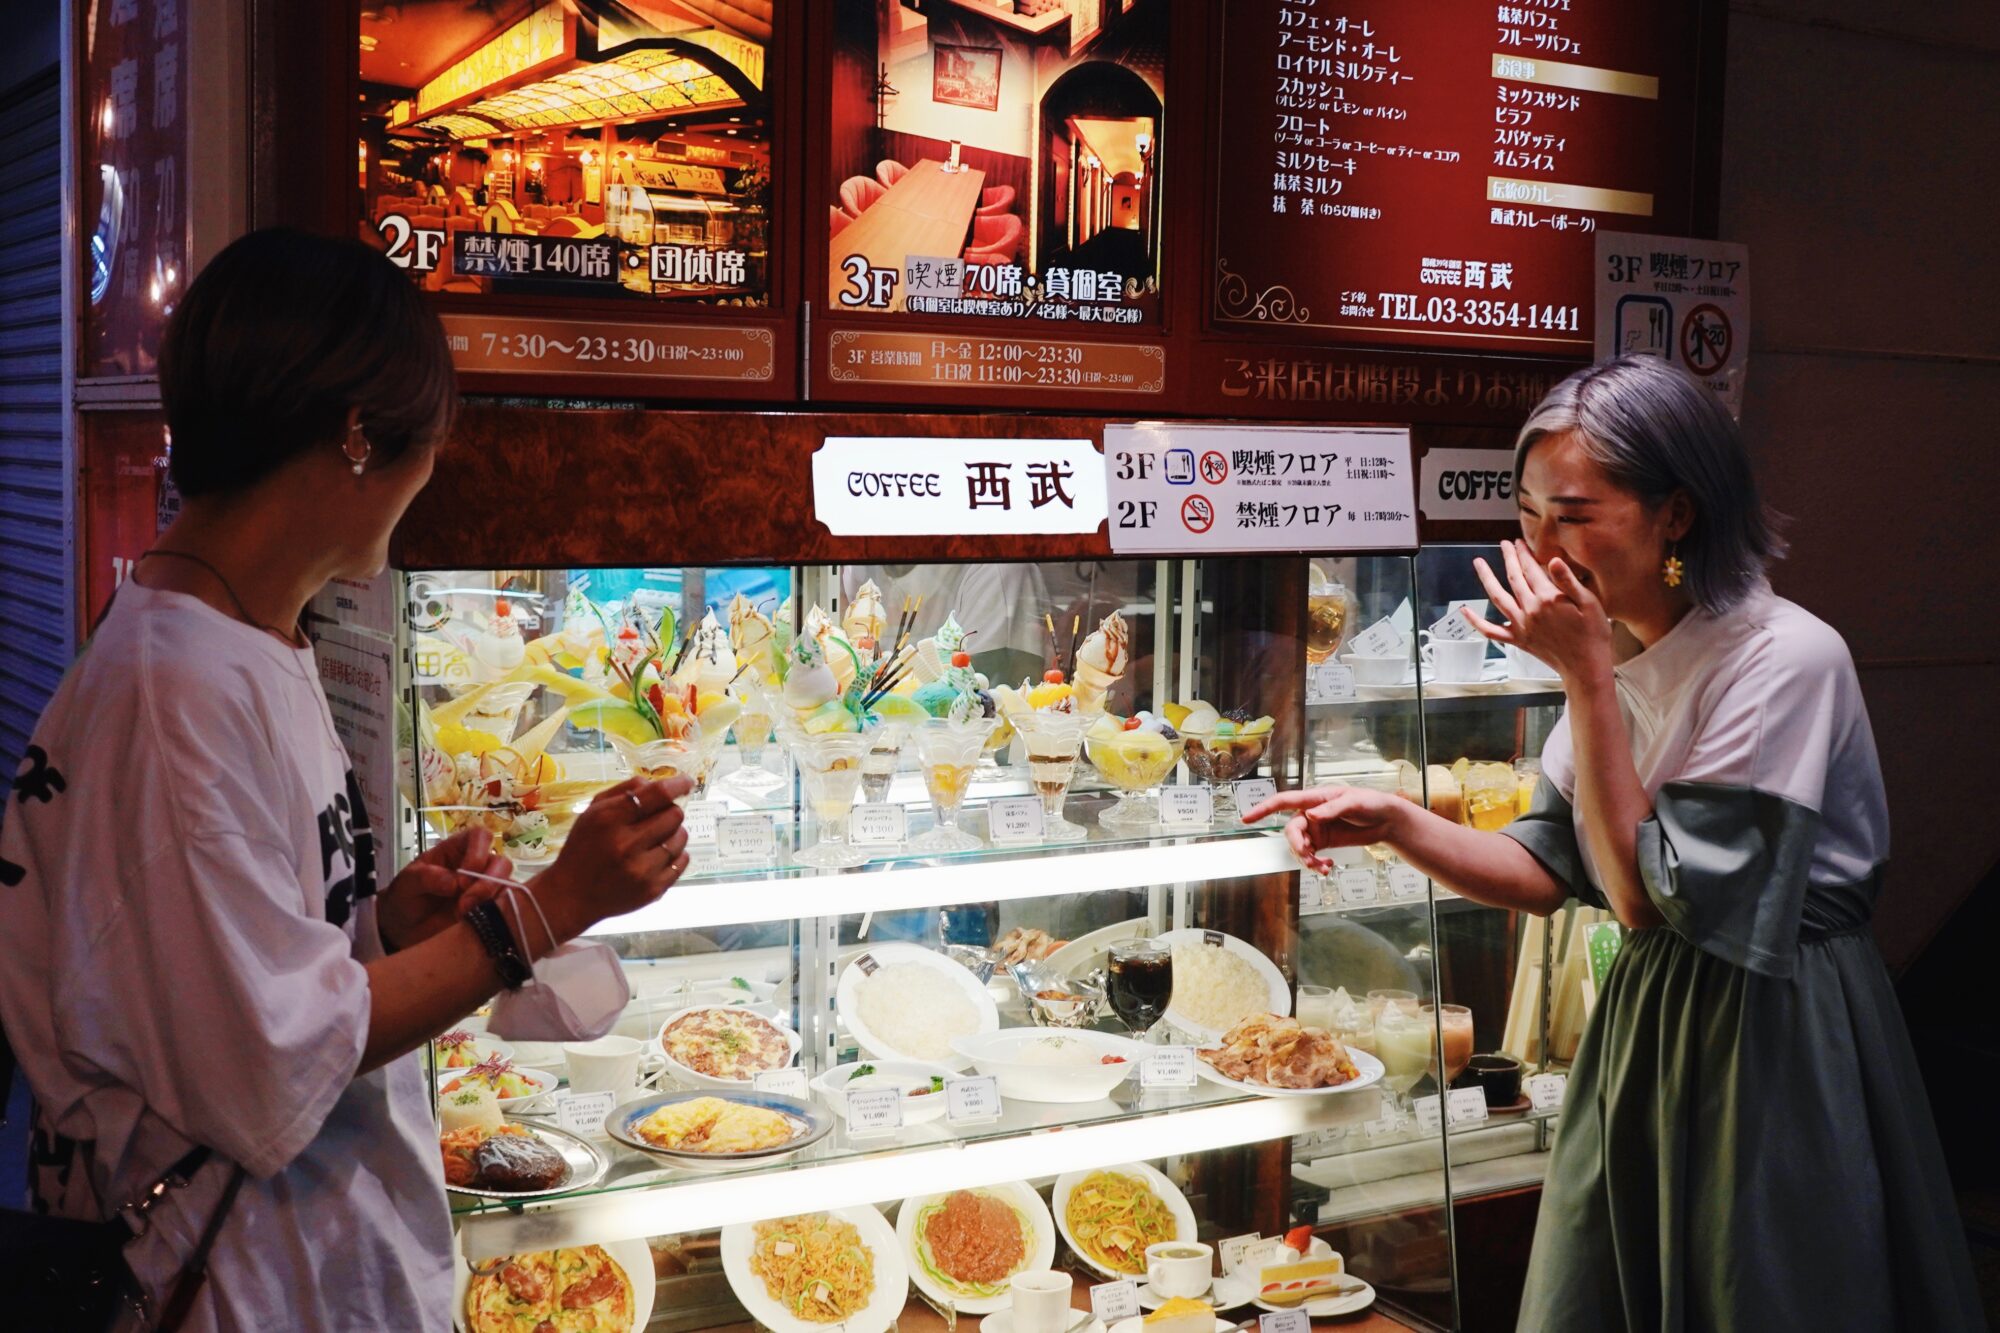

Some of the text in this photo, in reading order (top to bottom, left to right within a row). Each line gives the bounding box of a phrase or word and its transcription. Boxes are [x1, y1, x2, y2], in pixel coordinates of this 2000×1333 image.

[1279, 8, 1375, 37] カフェ・オーレ
[1497, 5, 1558, 30] 抹茶パフェ
[1278, 31, 1401, 62] アーモンド・オーレ
[1498, 28, 1581, 54] フルーツパフェ
[1278, 54, 1413, 85] ロイヤルミルクティー
[1497, 58, 1535, 80] お食事
[1277, 77, 1344, 100] スカッシュ
[1497, 85, 1580, 111] ミックスサンド
[1334, 102, 1360, 115] レモン
[1495, 107, 1532, 126] ピラフ
[1276, 114, 1330, 135] フロート
[1316, 136, 1341, 150] コーラ
[1354, 142, 1385, 154] コーヒー
[1494, 128, 1566, 151] スパゲッティ
[1276, 151, 1357, 176] ミルクセーキ
[1493, 149, 1555, 171] オムライス
[1273, 173, 1342, 195] 抹茶ミルク
[1492, 181, 1568, 203] 伝統のカレー
[379, 215, 445, 270] 2F
[1420, 261, 1513, 290] COFFEE 西武
[1607, 252, 1741, 283] 3F 喫煙フロア
[841, 255, 897, 306] 3F
[907, 261, 961, 291] 喫煙
[1340, 291, 1367, 304] ご予約
[1340, 292, 1580, 331] お問合せ TEL.03-3354-1441
[848, 350, 922, 366] 3F 営業時間
[930, 363, 972, 381] 土日祝
[1221, 358, 1556, 411] ご来店は階段よりお越
[1115, 451, 1155, 480] 3F
[1232, 449, 1338, 477] 喫煙フロア
[847, 460, 1076, 511] COFFEE 西武
[1438, 470, 1513, 501] COFFE
[1117, 500, 1157, 529] 2F
[1235, 501, 1342, 529] 禁煙フロア
